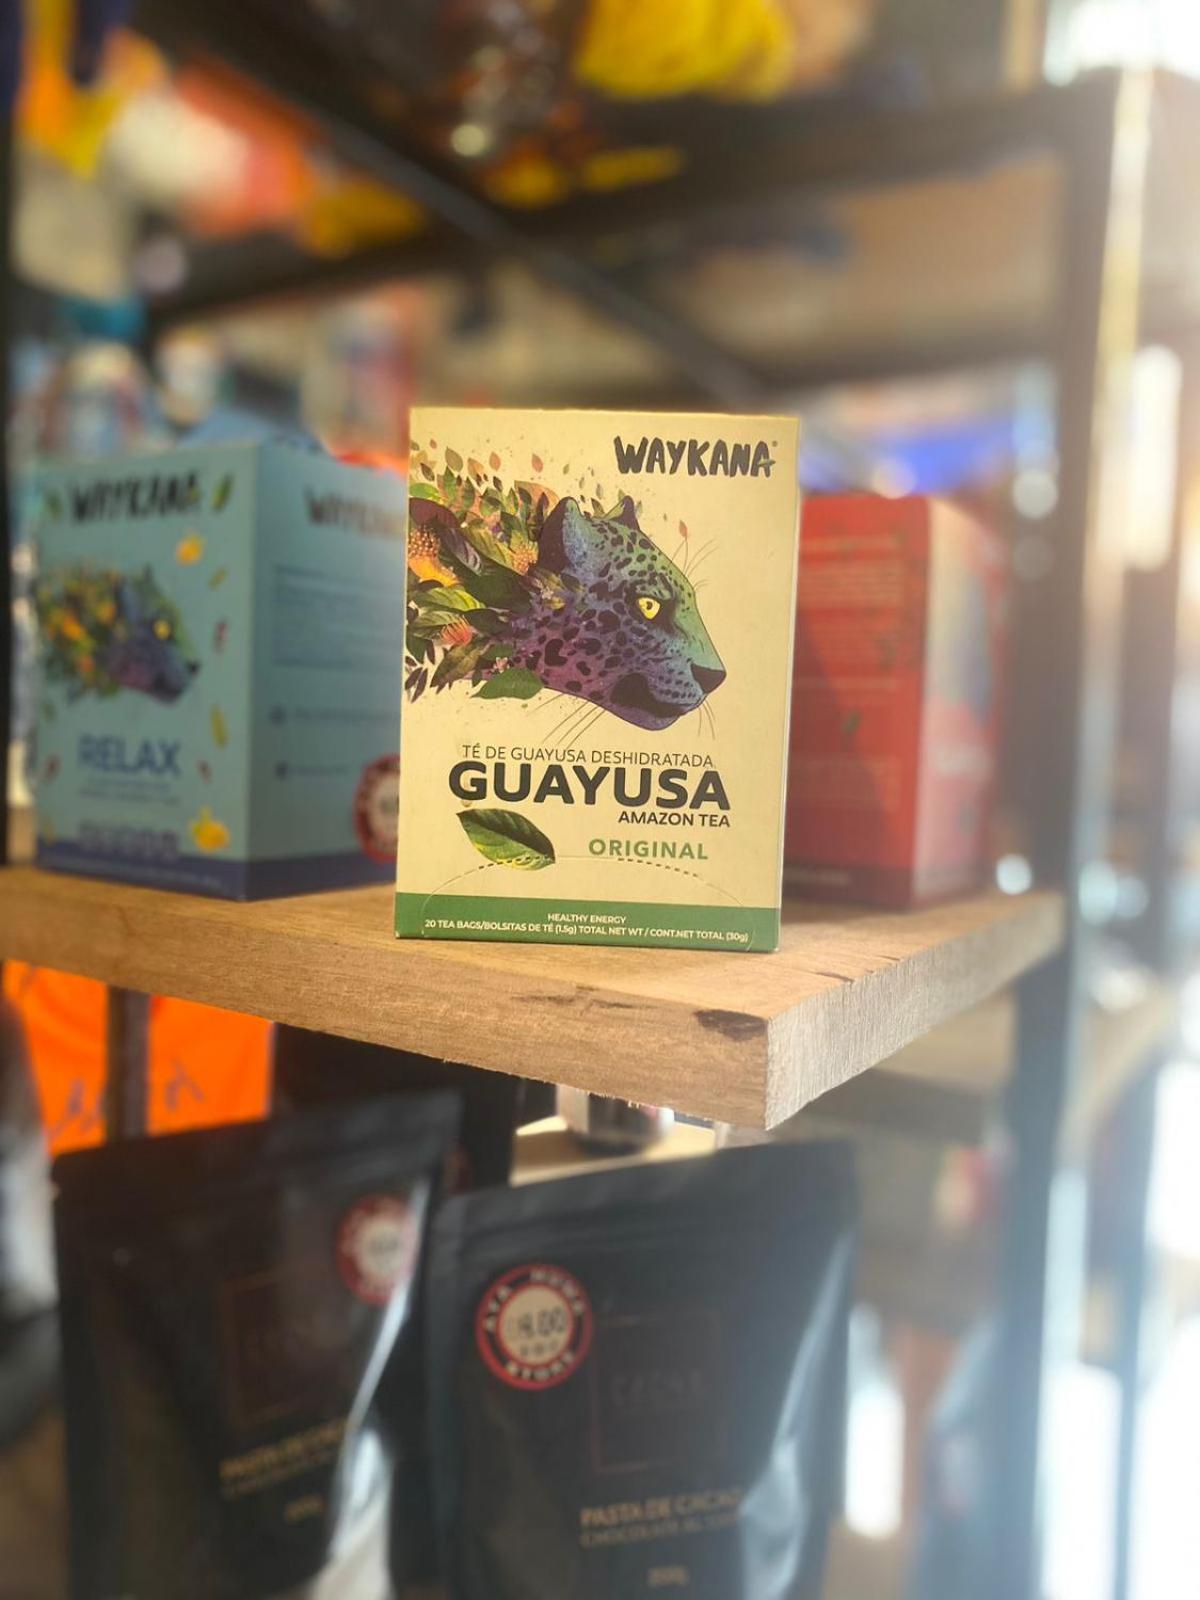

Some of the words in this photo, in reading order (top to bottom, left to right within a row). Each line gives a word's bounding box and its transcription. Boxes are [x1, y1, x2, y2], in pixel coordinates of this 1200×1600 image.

[613, 435, 774, 478] WAYKANA
[79, 734, 182, 779] RELAX
[462, 743, 479, 758] TÉ
[485, 746, 506, 760] DE
[511, 747, 587, 763] GUAYUSA
[592, 751, 716, 768] DESHIDRATADA
[449, 760, 731, 811] GUAYUSA
[618, 810, 693, 827] AMAZON
[698, 813, 731, 828] TEA
[588, 838, 709, 860] ORIGINAL
[424, 919, 436, 928] 20
[437, 920, 455, 929] TEA
[528, 923, 541, 932] DE
[578, 925, 607, 935] TOTAL
[609, 926, 626, 936] NET
[628, 927, 644, 937] WT
[696, 931, 724, 941] TOTAL
[547, 912, 588, 924] HEALTHY
[590, 914, 627, 925] ENERGY
